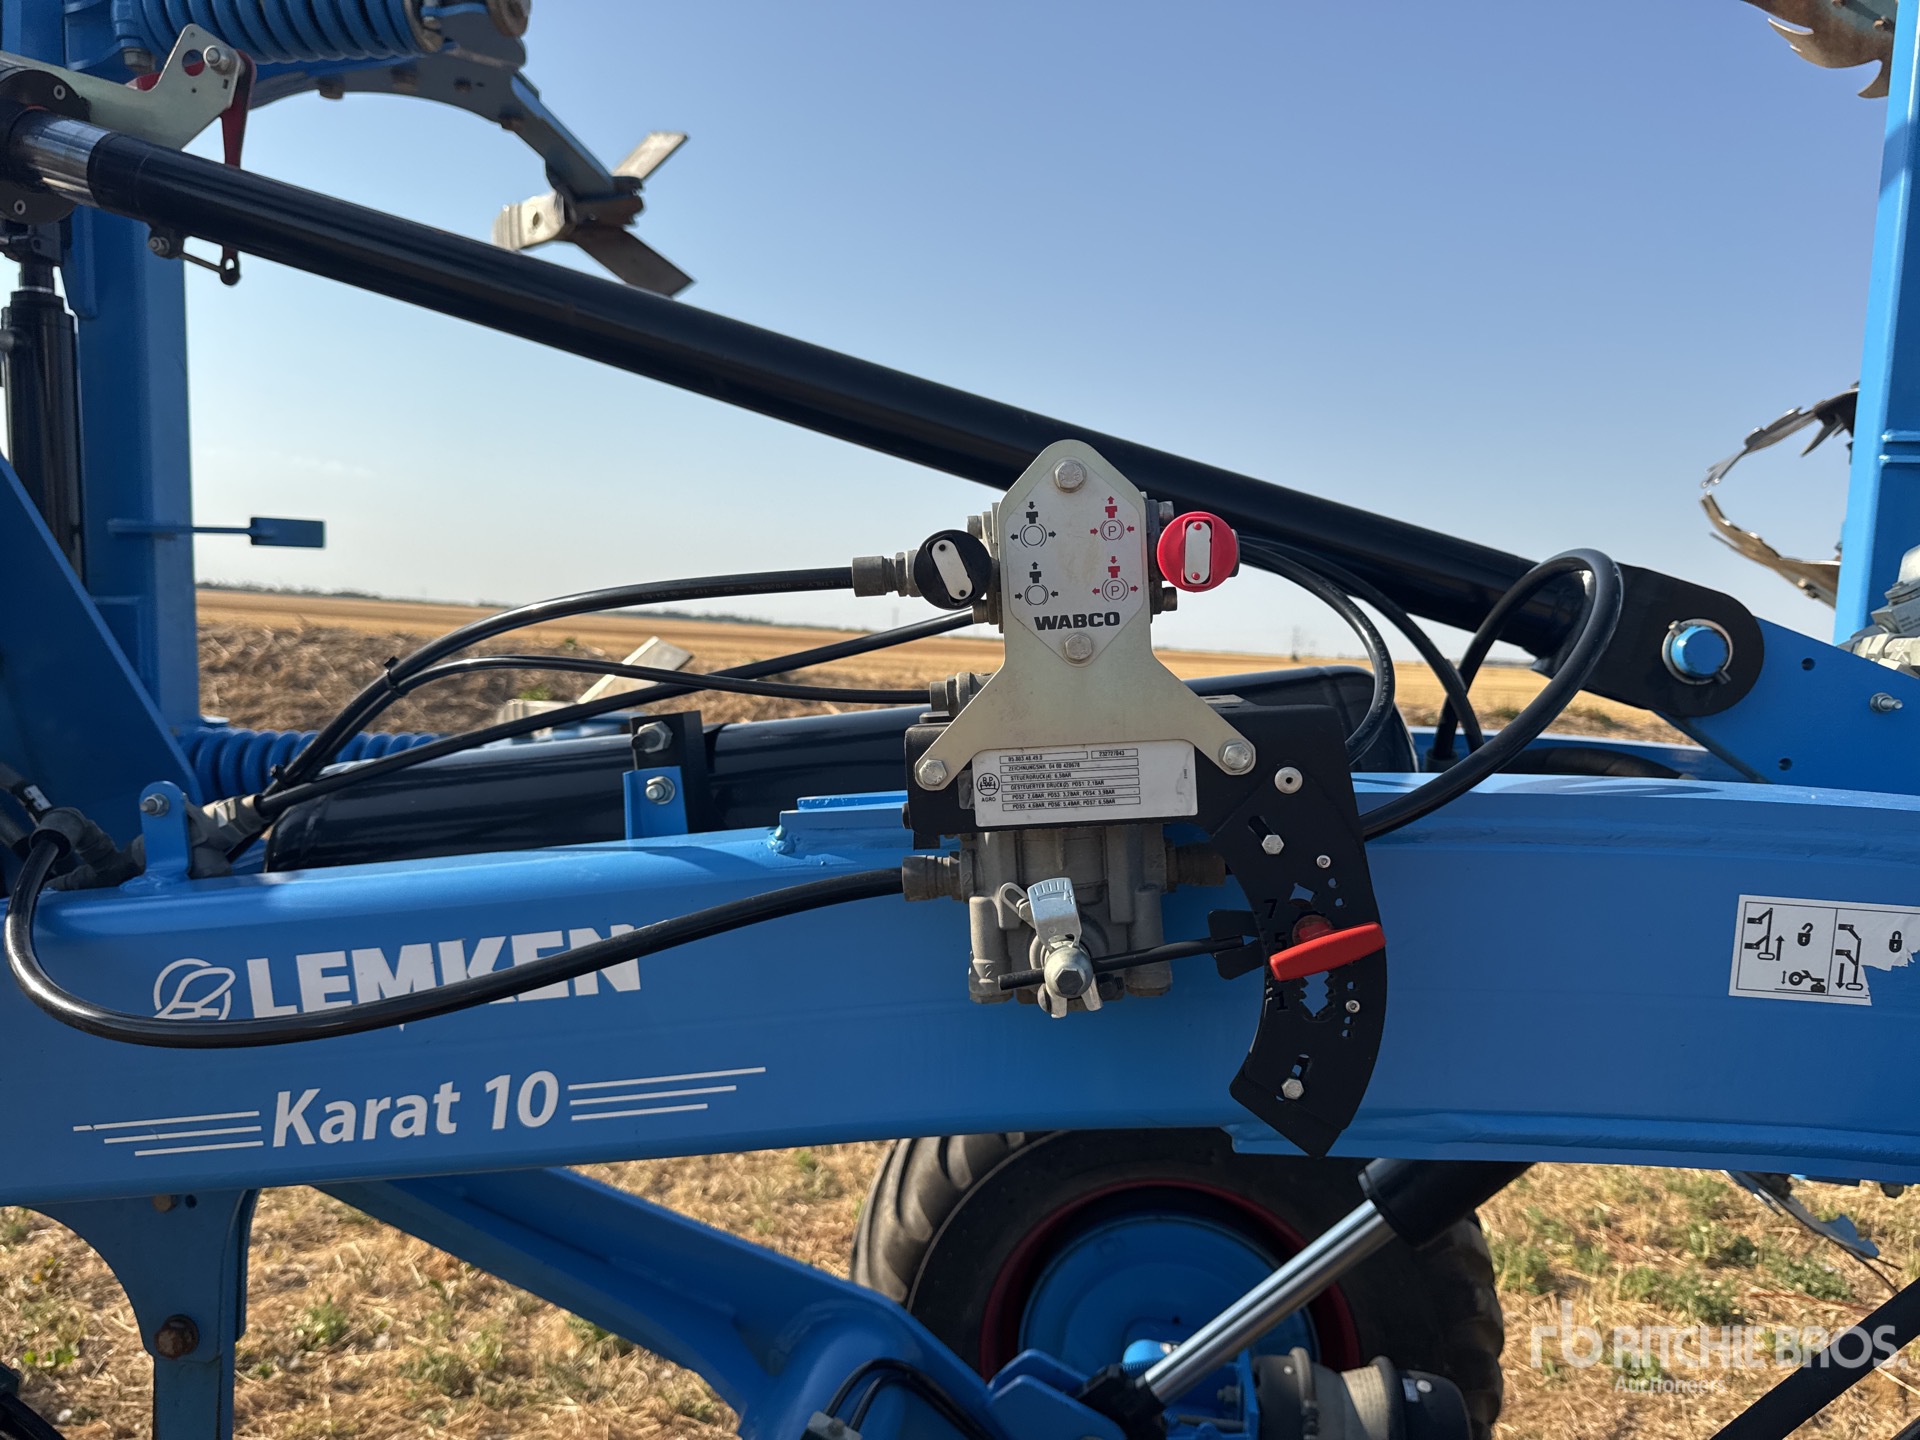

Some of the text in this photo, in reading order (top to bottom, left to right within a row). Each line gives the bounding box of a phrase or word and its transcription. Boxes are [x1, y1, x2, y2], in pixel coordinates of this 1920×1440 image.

[1107, 525, 1117, 537] P
[1110, 585, 1120, 597] P
[1034, 611, 1120, 631] WABCO
[1011, 783, 1046, 791] GESTEUERTER
[1264, 899, 1278, 919] 7
[246, 923, 642, 1030] LEMKEN
[272, 1070, 560, 1148] Karat 10
